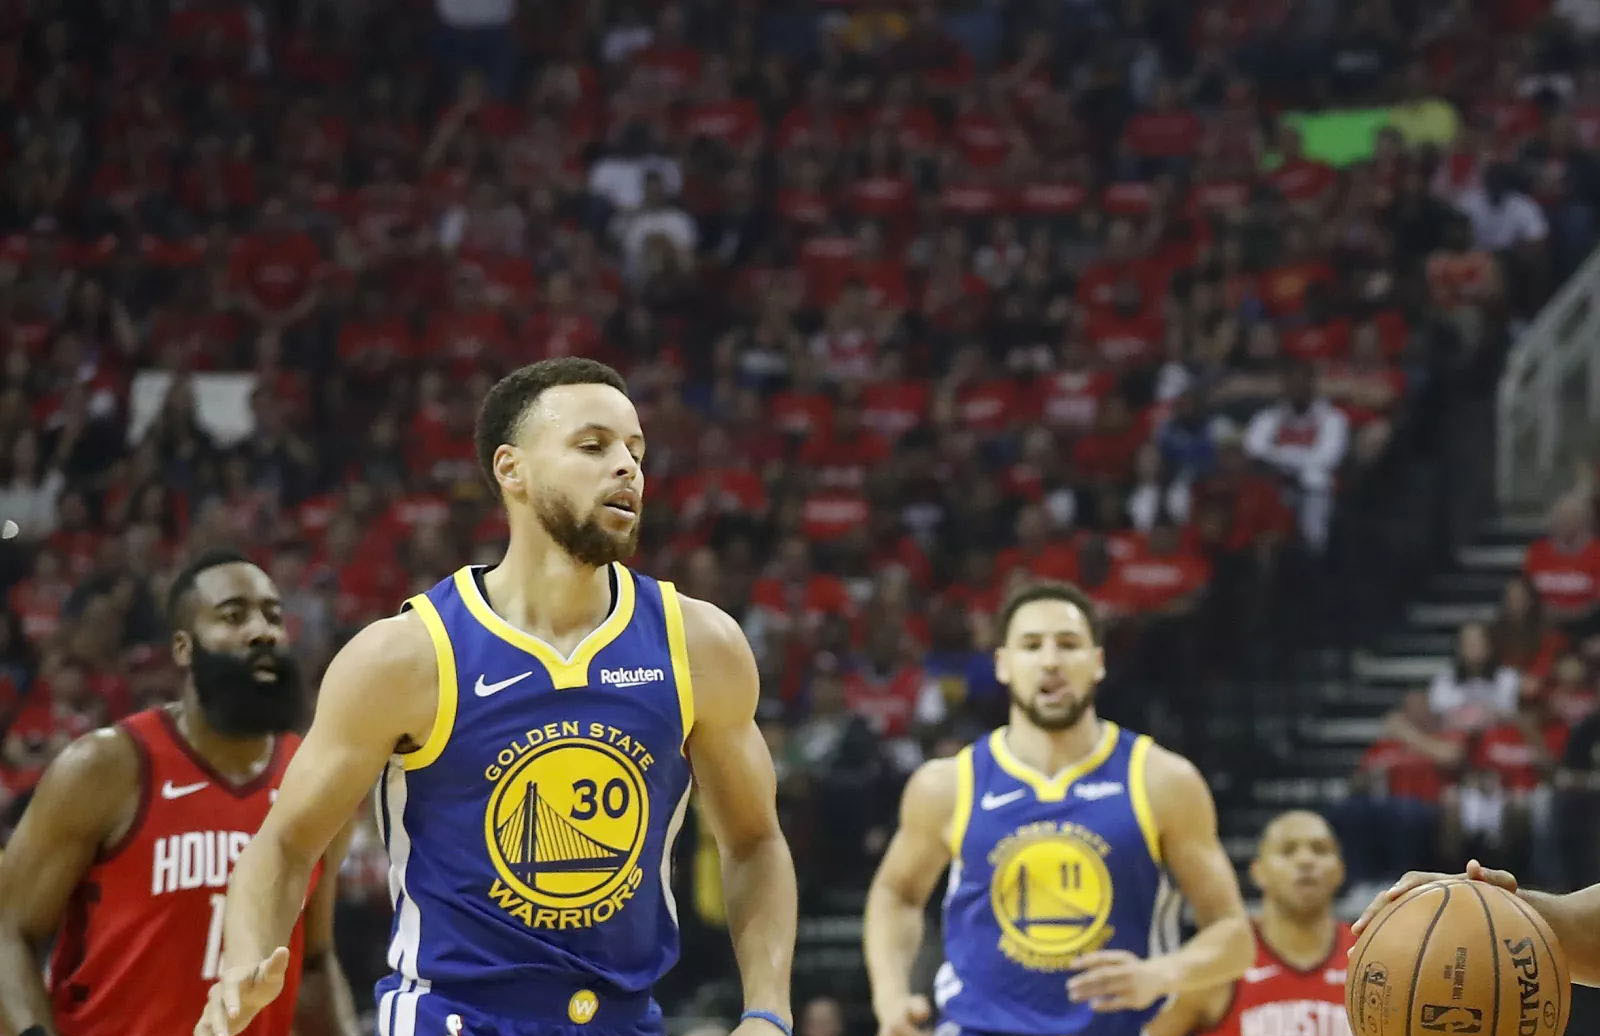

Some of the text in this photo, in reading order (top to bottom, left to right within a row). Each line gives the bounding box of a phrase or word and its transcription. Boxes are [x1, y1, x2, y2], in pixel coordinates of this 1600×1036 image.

[600, 667, 664, 686] Rakuten
[485, 721, 655, 781] GOLDEN STATE
[570, 778, 629, 821] 30
[1060, 862, 1081, 890] 11
[488, 864, 643, 930] WARRIORS
[574, 999, 596, 1016] W
